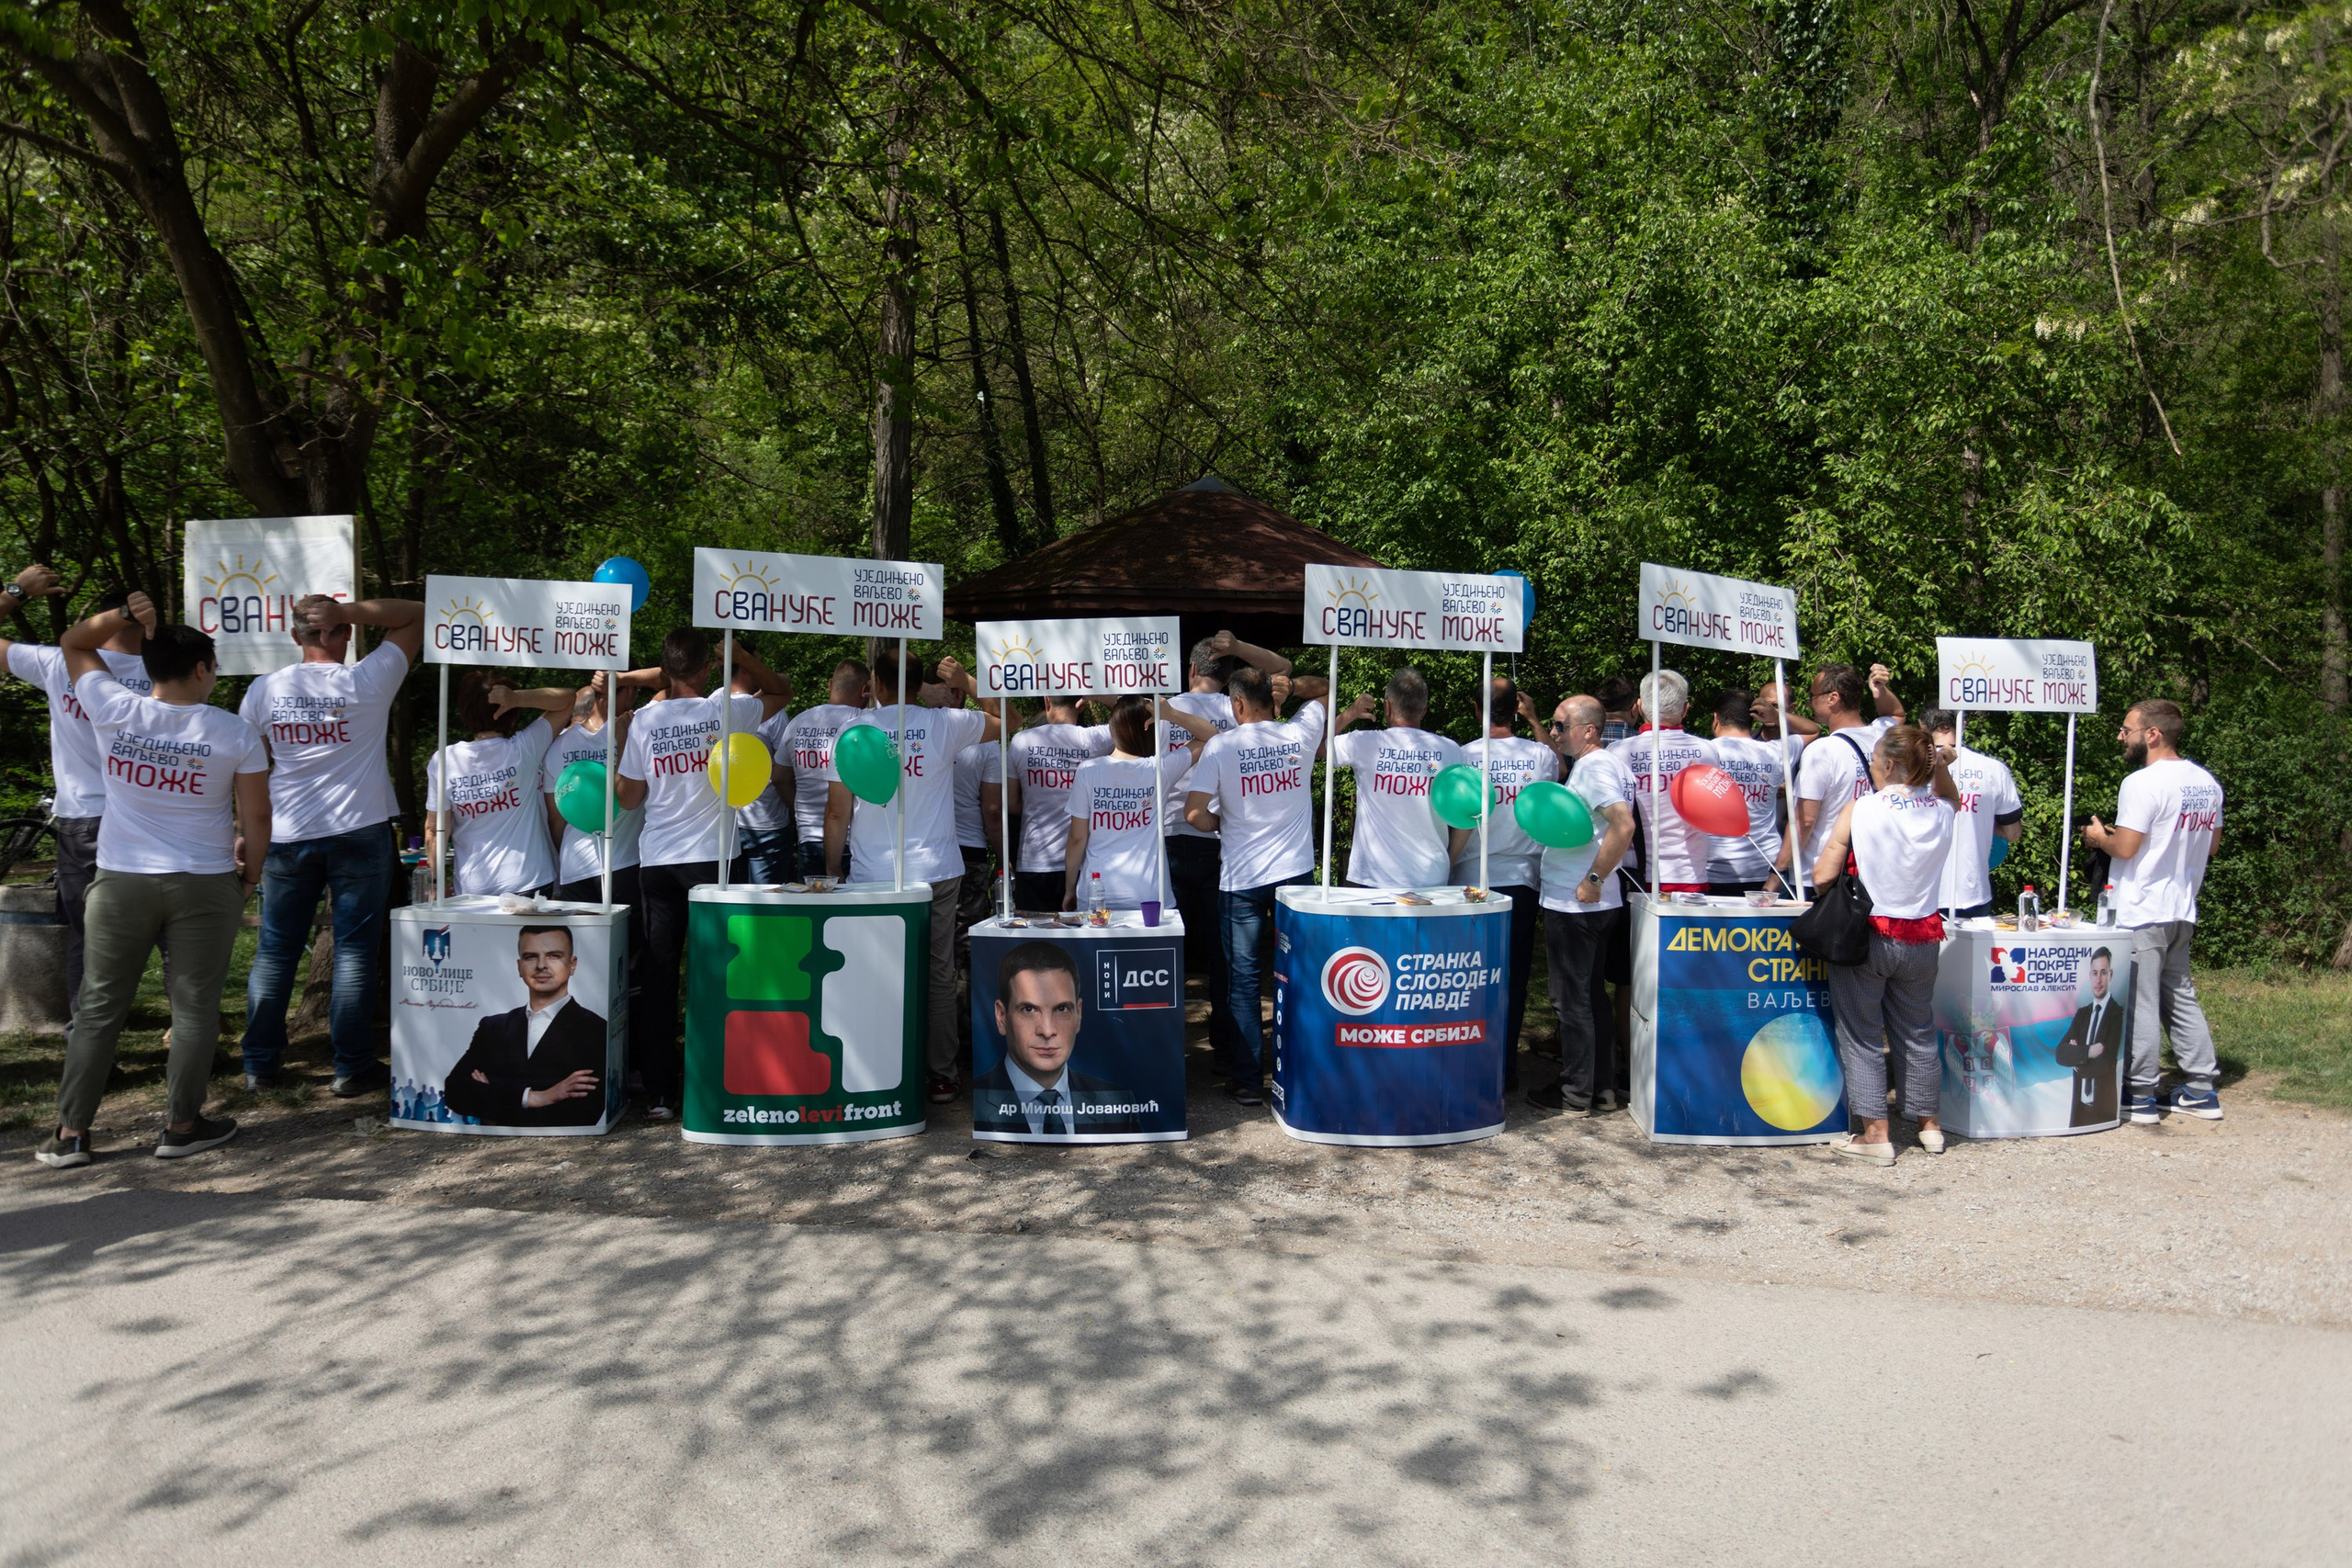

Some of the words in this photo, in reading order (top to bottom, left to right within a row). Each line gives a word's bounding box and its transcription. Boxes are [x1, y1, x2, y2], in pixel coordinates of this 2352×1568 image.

[854, 569, 924, 586] УЈЕДИЊЕНО
[854, 584, 902, 600] ВАЉЕВО
[1442, 583, 1505, 599] УЈЕДИЊЕНО
[556, 602, 620, 616] УЈЕДИЊЕНО
[715, 590, 835, 626] СВАНУЋЕ
[854, 601, 922, 630] МОЖЕ
[1442, 599, 1486, 614] ВАЉЕВО
[1739, 592, 1783, 610] УЈЕДИЊЕНО
[199, 593, 347, 634] СВАН
[1739, 606, 1770, 622] ВАЉЕВО
[555, 616, 599, 630] ВАЉЕВО
[1322, 606, 1426, 640] СВАНУЋЕ
[1442, 615, 1504, 643] МОЖЕ
[1653, 604, 1732, 641] СВАНУЋЕ
[1740, 620, 1785, 649] МОЖЕ
[435, 624, 544, 654] СВАНУЋЕ
[555, 631, 619, 657] МОЖЕ
[1103, 632, 1169, 646] УЈЕДИЊЕНО
[1104, 648, 1148, 661] ВАЉЕВО
[2042, 653, 2087, 667] УЈЕДИЊЕНО
[989, 662, 1093, 691] СВАНУЋЕ
[1104, 662, 1169, 688] МОЖЕ
[2042, 668, 2075, 680] ВАЉЕВО
[1950, 677, 2035, 704] СВАНУЋЕ
[2043, 682, 2087, 705] МОЖЕ
[272, 696, 346, 709] УЈЕДИЊЕНО
[271, 710, 325, 722] ВАЉЕВО
[271, 721, 351, 745] МОЖЕ
[650, 719, 720, 741] УЈЕДИЊЕНО
[796, 727, 838, 738] УЈЕДИЊЕ
[116, 728, 211, 757] УЈЕДИЊЕНО
[651, 737, 700, 755] ВАЉЕВО
[795, 738, 829, 749] ВАЉЕВО
[1238, 742, 1301, 761] УЈЕДИЊЕНО
[110, 741, 179, 767] ВАЉЕВО
[794, 750, 830, 770] МОЖ
[1028, 746, 1090, 759] УЈЕДИЊЕНО
[1378, 748, 1442, 761] УЈЕДИЊЕНО
[653, 749, 709, 778] МОЖ
[1027, 757, 1070, 769] ВАЉЕВО
[1240, 757, 1283, 774] ВАЉЕВО
[1376, 761, 1421, 773] ВАЉЕВО
[107, 754, 208, 795] МОЖЕ
[449, 766, 517, 789] УЈЕДИЊЕНО
[1027, 769, 1076, 790] МОЖ
[1241, 766, 1302, 797] МОЖЕ
[451, 784, 500, 802] ВАЉЕВО
[1093, 786, 1155, 799] УЈЕДИЊЕНО
[1374, 773, 1434, 796] МОЖ
[455, 787, 522, 819] МОЖЕ
[1093, 798, 1137, 811] ВАЉЕВО
[1092, 807, 1153, 831] МОЖЕ
[2174, 811, 2216, 832] МОЖЕ
[1396, 951, 1482, 972] СТРАНКА
[2028, 947, 2092, 960] НАРОДНИ
[403, 965, 434, 977] НОВО
[439, 967, 473, 981] ЛИЦЕ
[1748, 957, 1827, 983] СТРАН
[2028, 959, 2079, 971] ПОКРЕТ
[411, 977, 464, 996] СРБИЈЕ
[1123, 969, 1169, 987] ДСС
[1396, 968, 1487, 991] СЛОБОДЕ
[1489, 967, 1501, 985] И
[2027, 972, 2076, 984] СРБИЈЕ
[2041, 984, 2076, 992] АЛЕКСИЋ
[1395, 990, 1471, 1011] ПРАВДЕ
[1747, 991, 1831, 1009] ВАЉЕВ
[1340, 1027, 1406, 1044] МОЖЕ
[1410, 1024, 1482, 1043] СРБИЈА
[723, 1100, 902, 1123] zelenolevifront
[999, 1103, 1017, 1116] др
[1021, 1101, 1073, 1115] Милош
[1077, 1100, 1159, 1115] Јовановић
